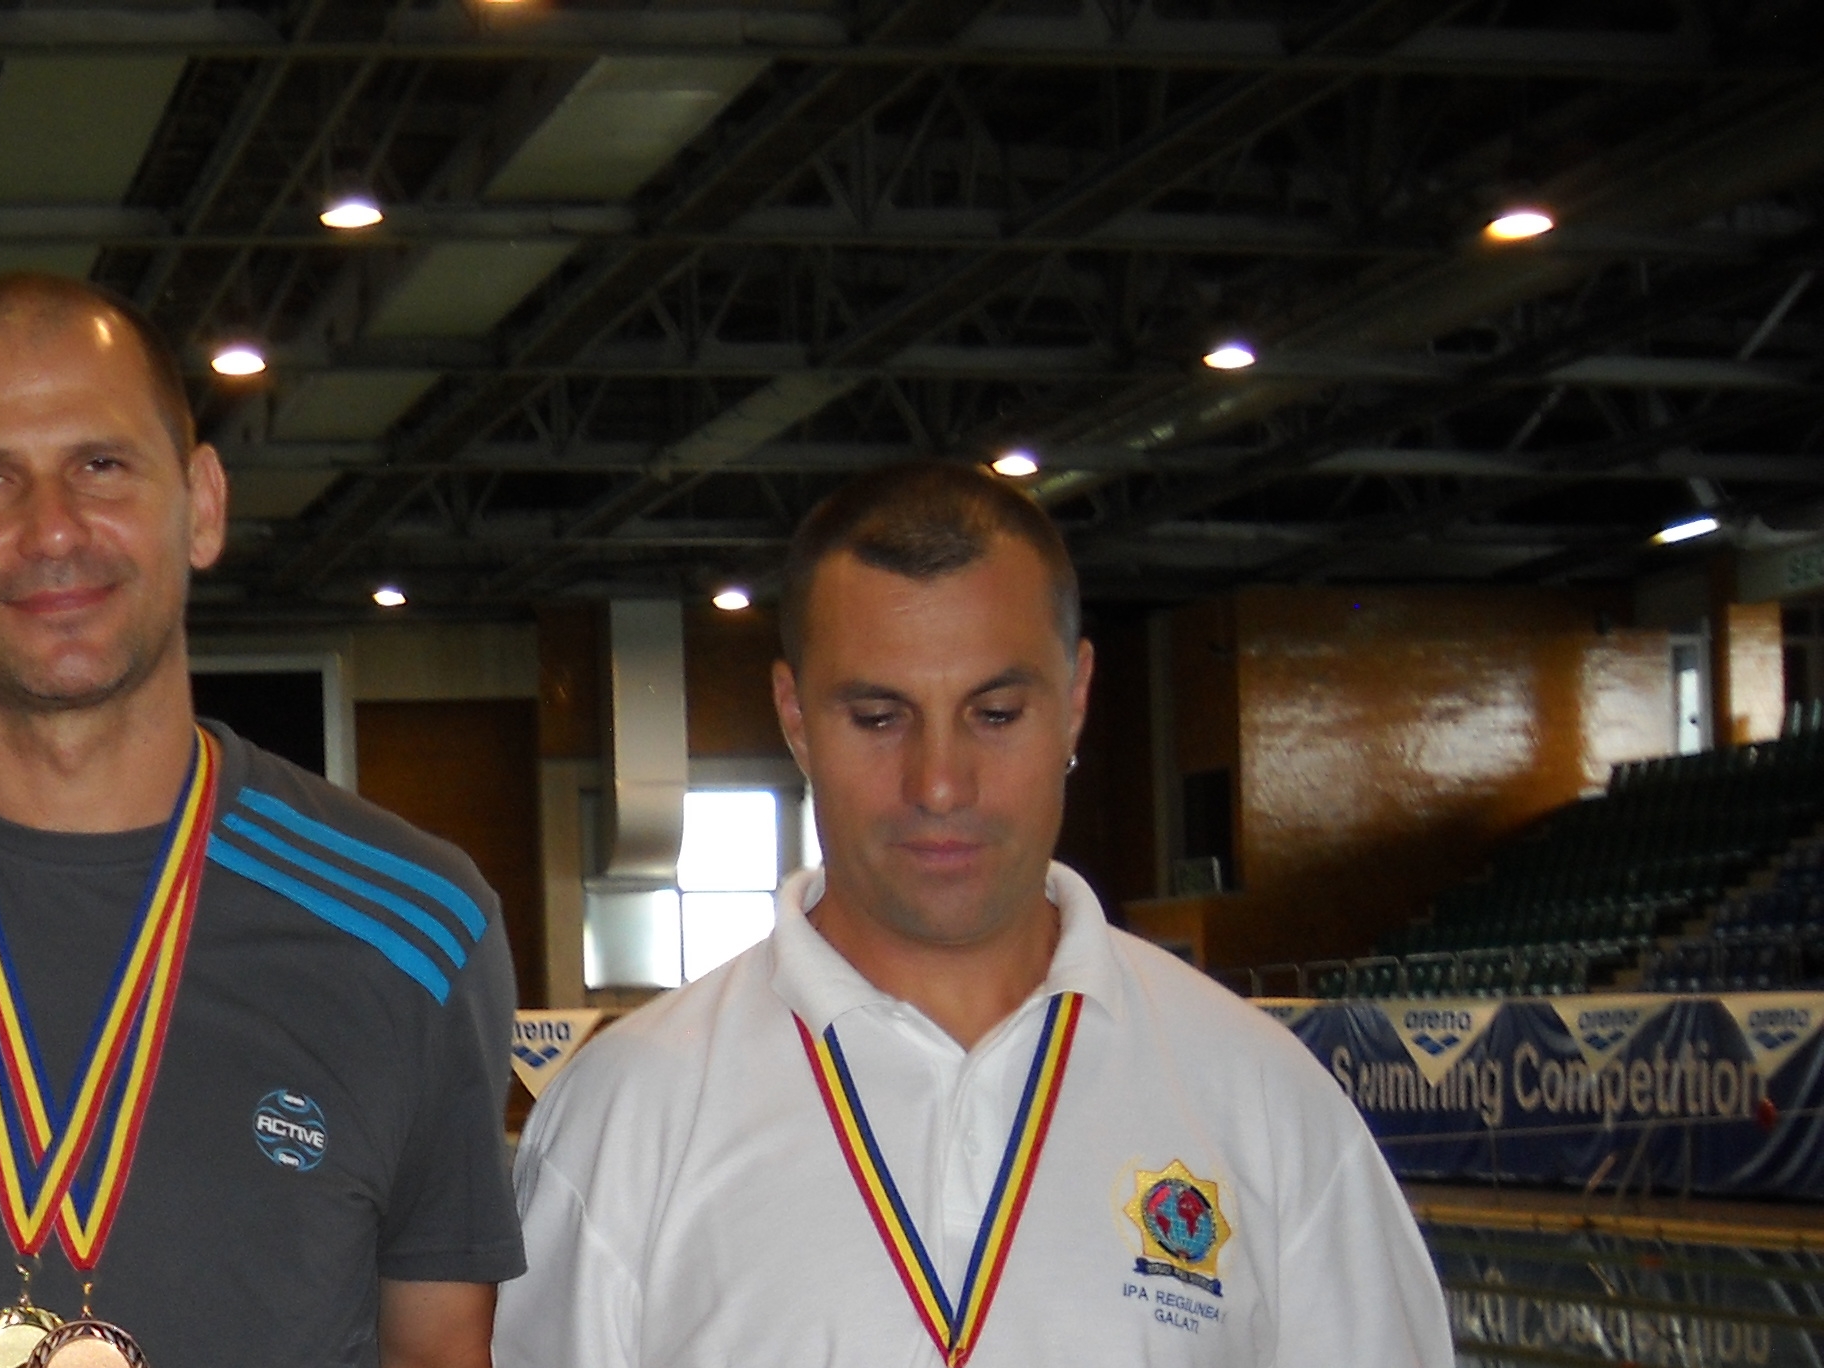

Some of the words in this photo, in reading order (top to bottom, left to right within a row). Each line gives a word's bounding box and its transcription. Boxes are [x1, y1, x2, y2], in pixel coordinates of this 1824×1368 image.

[1404, 1010, 1472, 1030] arena
[1580, 1010, 1640, 1029] arena
[1749, 1009, 1811, 1028] arena
[513, 1021, 571, 1041] rena
[257, 1115, 325, 1149] ACTIVE
[1123, 1283, 1149, 1301] IPA
[1156, 1290, 1220, 1322] REGIUNEA
